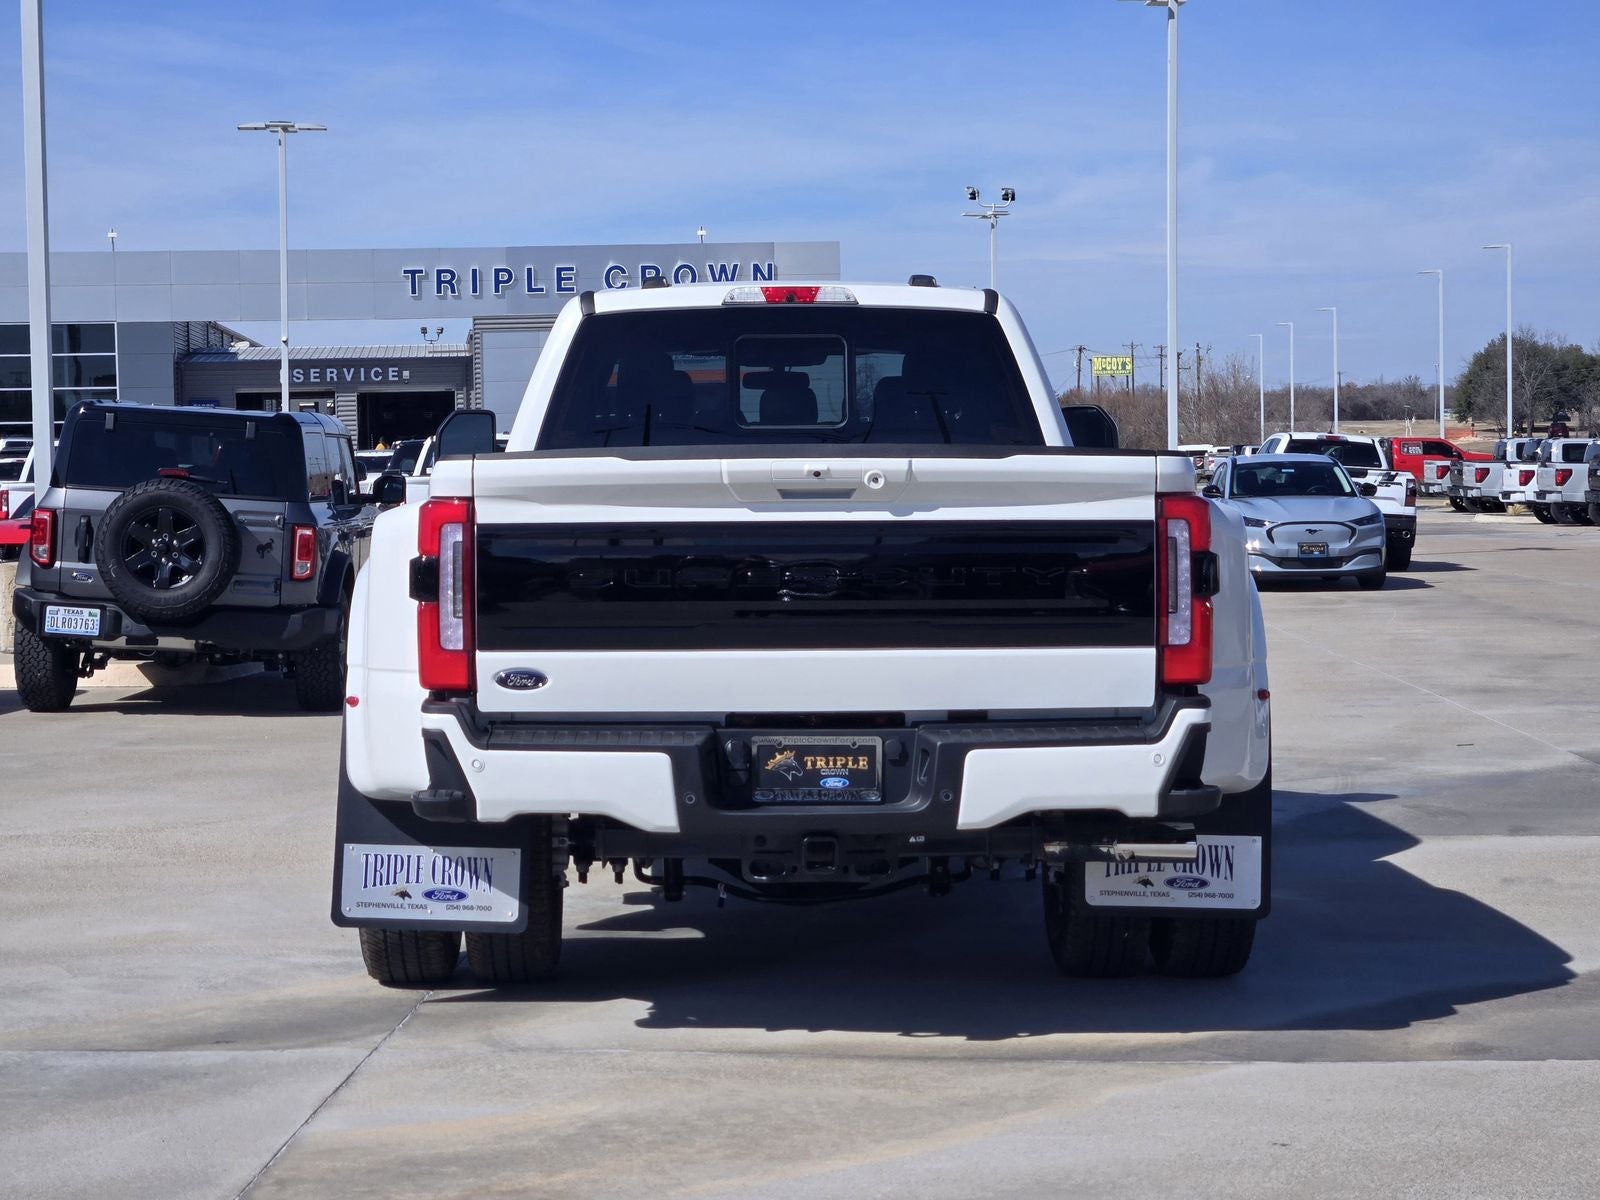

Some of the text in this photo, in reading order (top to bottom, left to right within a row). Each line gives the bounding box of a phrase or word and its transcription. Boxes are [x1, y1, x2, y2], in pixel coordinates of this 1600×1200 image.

[402, 263, 775, 296] TRIPLE CROWN
[292, 367, 399, 383] SERVICE
[50, 616, 95, 630] DLR03763
[804, 756, 869, 770] TRIPLE
[362, 853, 495, 894] TRIPLE CROWN
[1099, 890, 1149, 898] STEPHENVILLE,
[356, 901, 407, 910] STEPHENVILLE,
